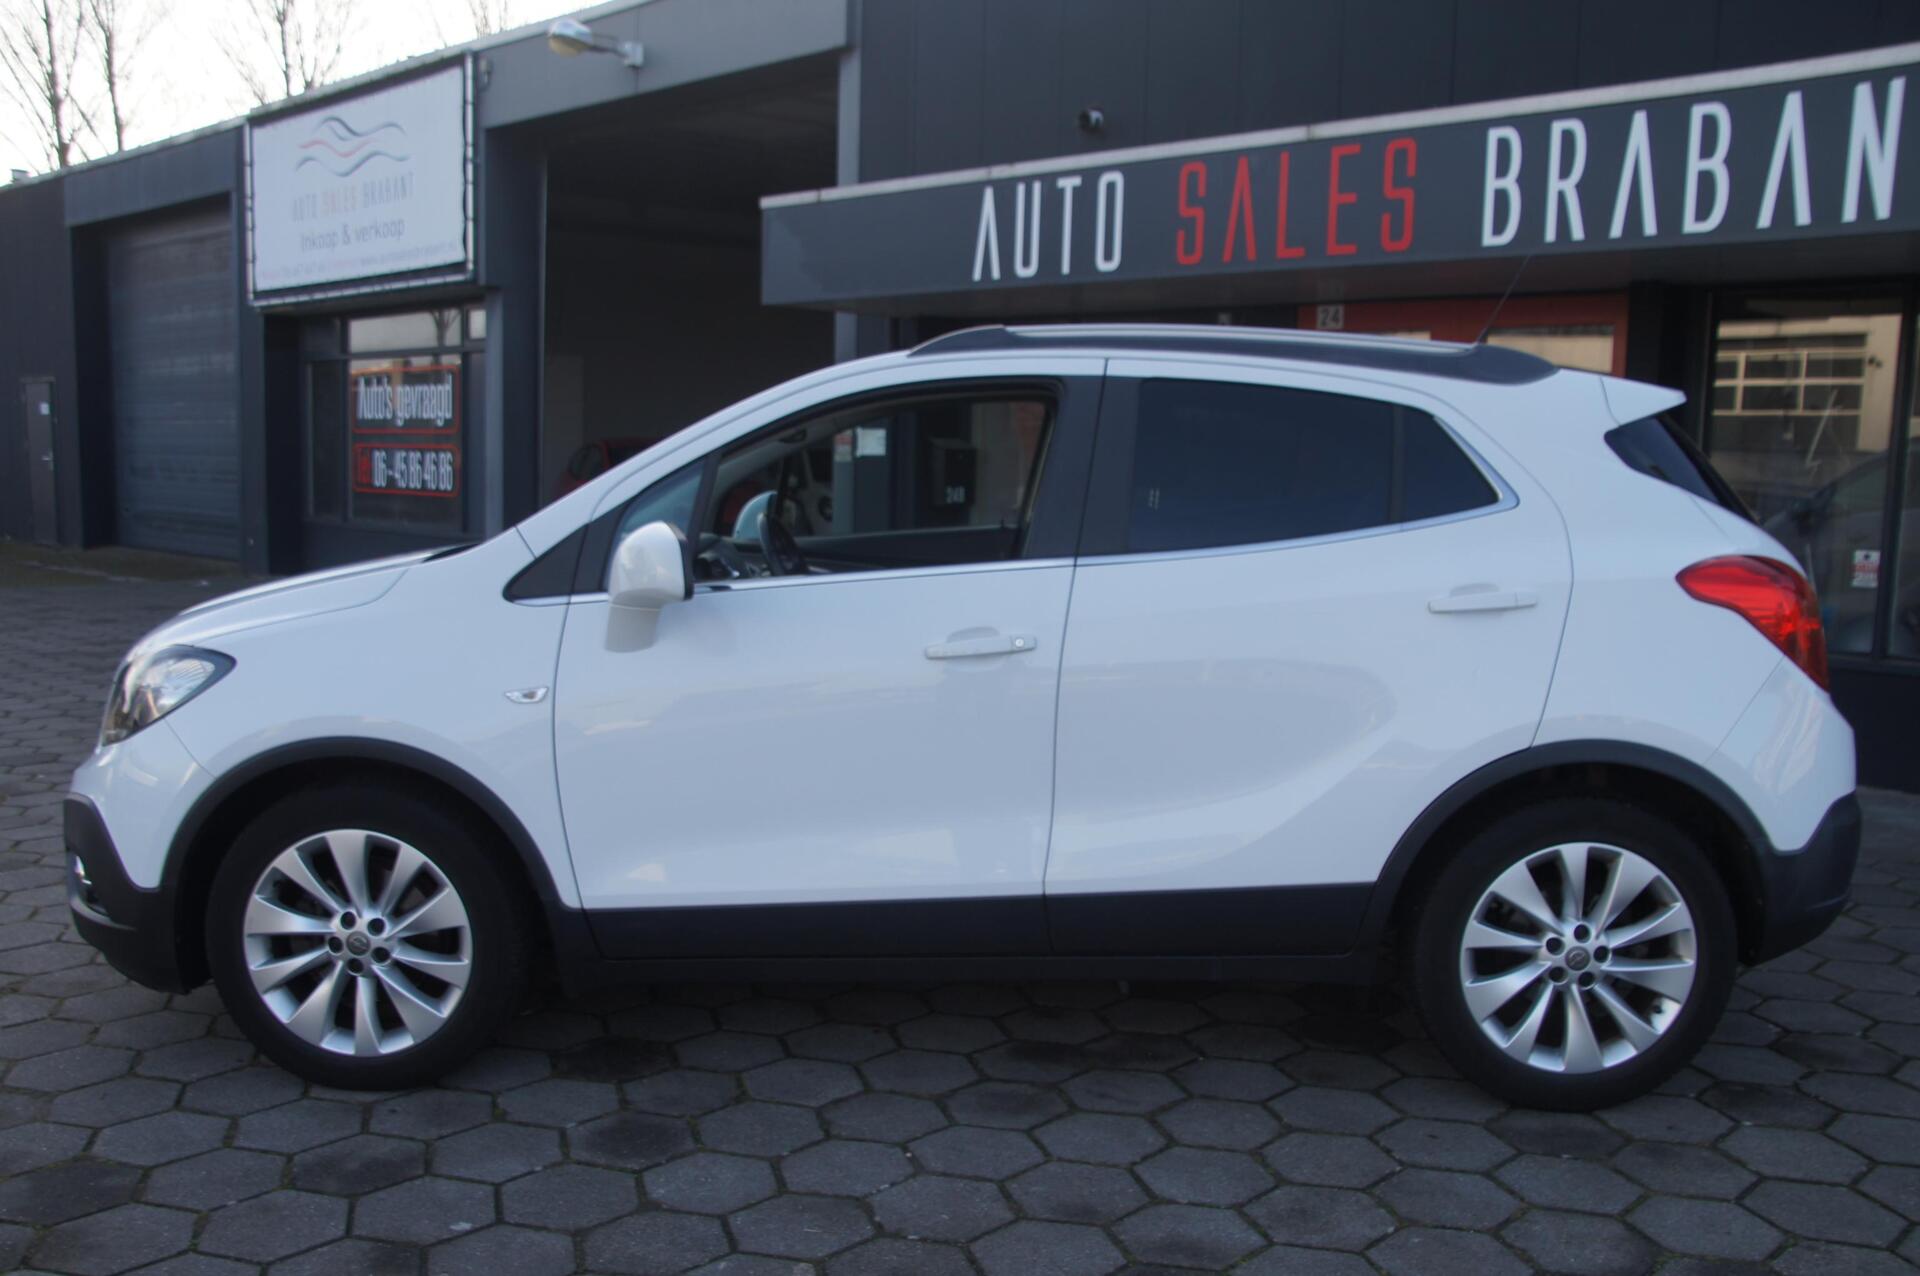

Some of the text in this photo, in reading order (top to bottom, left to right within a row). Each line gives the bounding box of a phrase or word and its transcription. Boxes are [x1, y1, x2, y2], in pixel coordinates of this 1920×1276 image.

[973, 78, 1905, 282] AUTO SALES BRABAN
[342, 223, 351, 245] &
[355, 217, 405, 242] verkoop
[1320, 308, 1340, 326] 24
[396, 373, 453, 427] gevraagd
